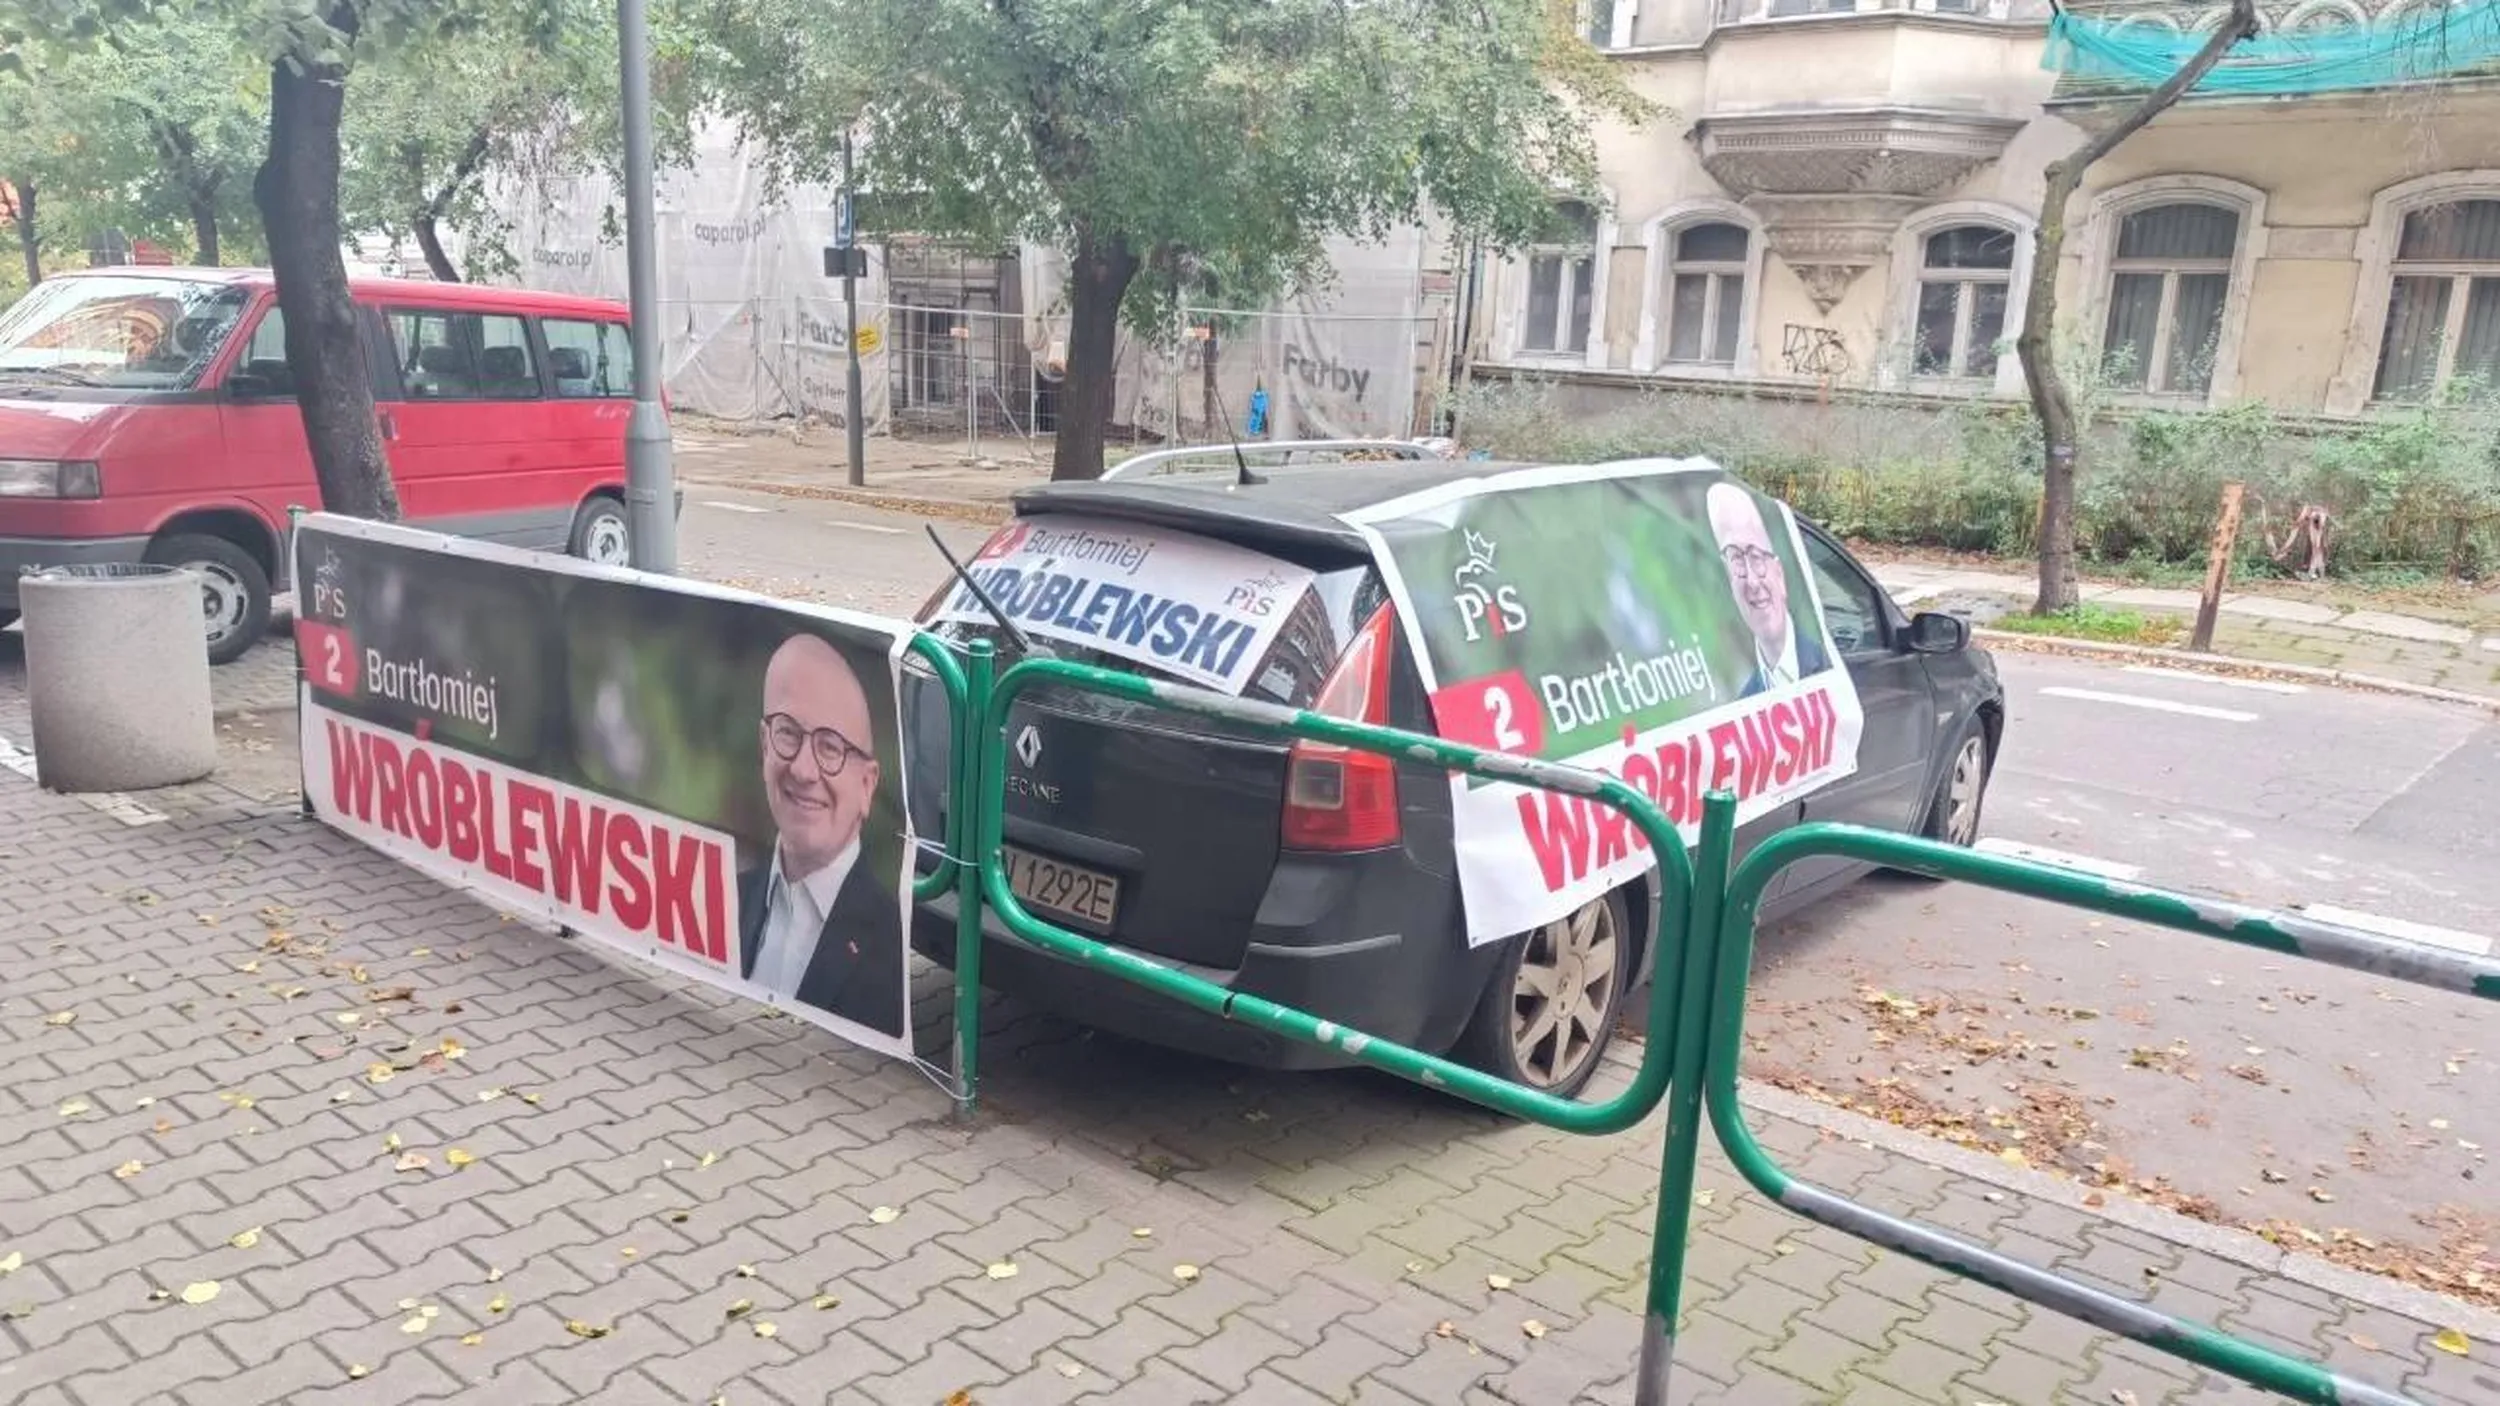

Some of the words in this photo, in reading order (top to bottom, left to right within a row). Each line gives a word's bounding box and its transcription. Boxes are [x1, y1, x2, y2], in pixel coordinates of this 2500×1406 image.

[694, 217, 767, 247] caparol.pl
[800, 311, 848, 346] Farb
[1282, 343, 1370, 402] Farby
[1023, 530, 1155, 577] Bartłomiej
[1224, 586, 1275, 616] PiS
[1454, 585, 1527, 641] PiS
[324, 633, 344, 685] 2
[366, 648, 498, 740] Bartłomiej
[1484, 686, 1525, 750] 2
[1541, 634, 1715, 732] Bartłomiej
[1004, 775, 1062, 803] EGANE
[326, 718, 728, 965] WRÓBLEWSKI
[1026, 858, 1114, 921] 1292E
